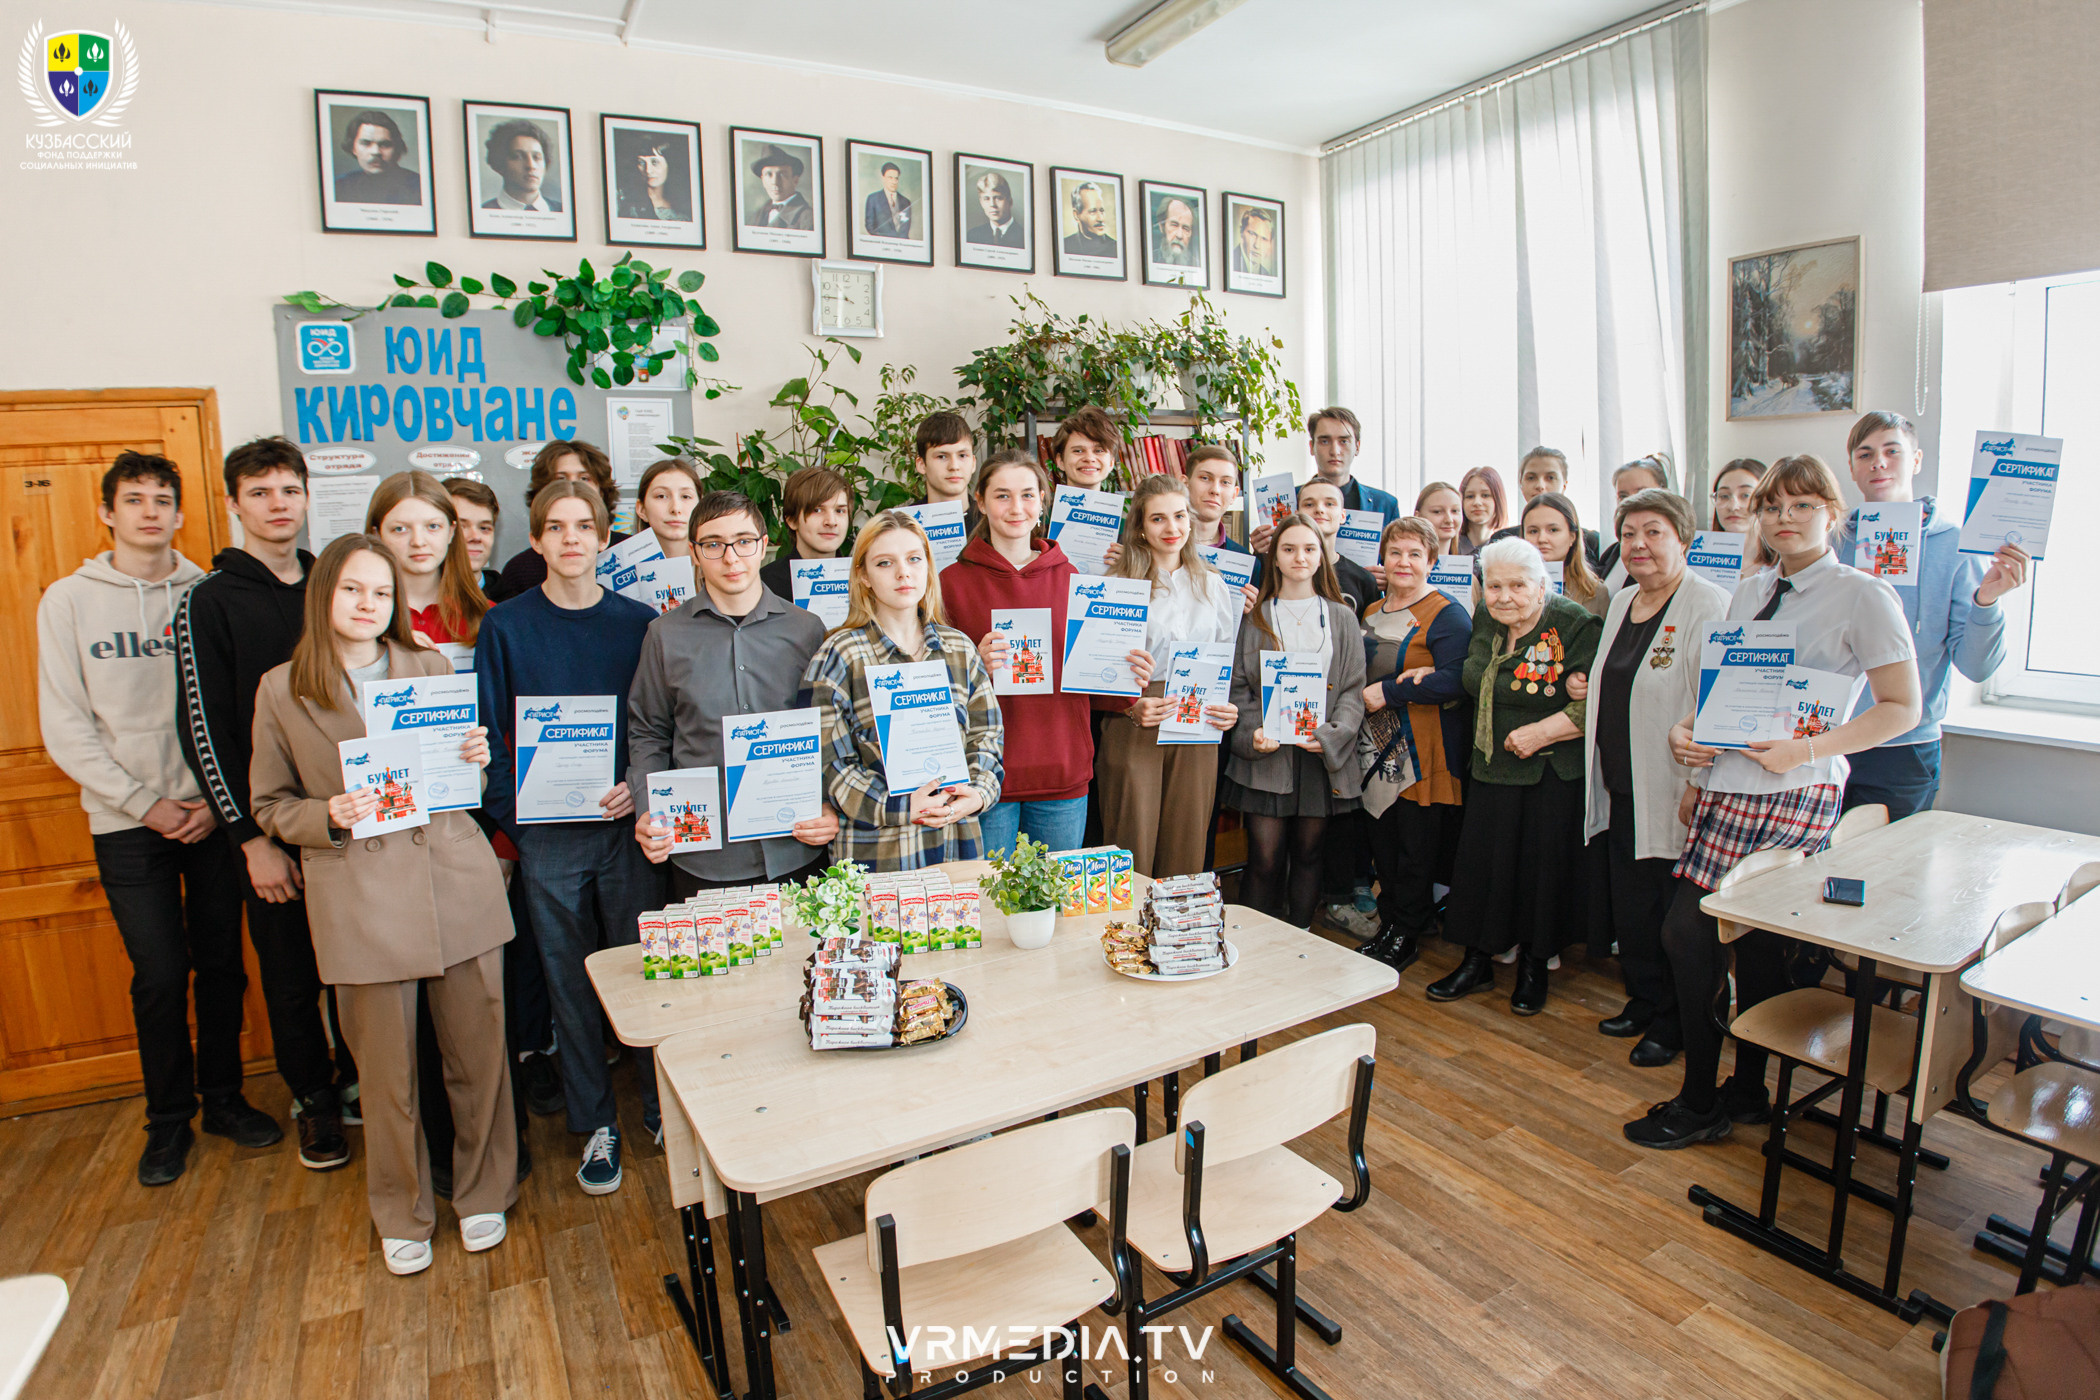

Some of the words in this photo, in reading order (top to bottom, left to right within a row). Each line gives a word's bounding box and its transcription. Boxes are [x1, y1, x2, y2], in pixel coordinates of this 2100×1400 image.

[385, 326, 487, 383] ЮИД
[309, 454, 365, 462] Структура
[1997, 462, 2056, 477] СЕРТИФИКАТ
[1071, 511, 1117, 526] СЕРТИФИКАТ
[924, 526, 960, 538] РТИФИКАТ
[1340, 529, 1378, 540] СЕРТИФИКАТ
[1875, 531, 1909, 541] БУКЛЕТ
[1690, 555, 1738, 566] СЕРТИФИКАТ
[1430, 575, 1469, 583] СЕРТИФИКАТ
[655, 587, 686, 600] БУКЛЕТ
[1091, 605, 1145, 618] СЕРТИФИКАТ
[89, 631, 176, 659] elles
[1010, 639, 1042, 649] БУКЛЕТ
[1728, 652, 1790, 663] СЕРТИФИКАТ
[894, 690, 947, 706] СЕРТИФИКАТ
[1798, 701, 1836, 718] БУКЛЕТ
[399, 708, 471, 725] СЕРТИФИКАТ
[545, 727, 609, 739] СЕРТИФИКАТ
[753, 739, 815, 756] СЕРТИФИКАТ
[781, 755, 815, 763] УЧАСТНИКА
[367, 768, 409, 784] БУКЛЕТ
[670, 804, 707, 814] БУКЛЕТ
[1087, 860, 1106, 873] Мой
[1112, 857, 1130, 871] Мой
